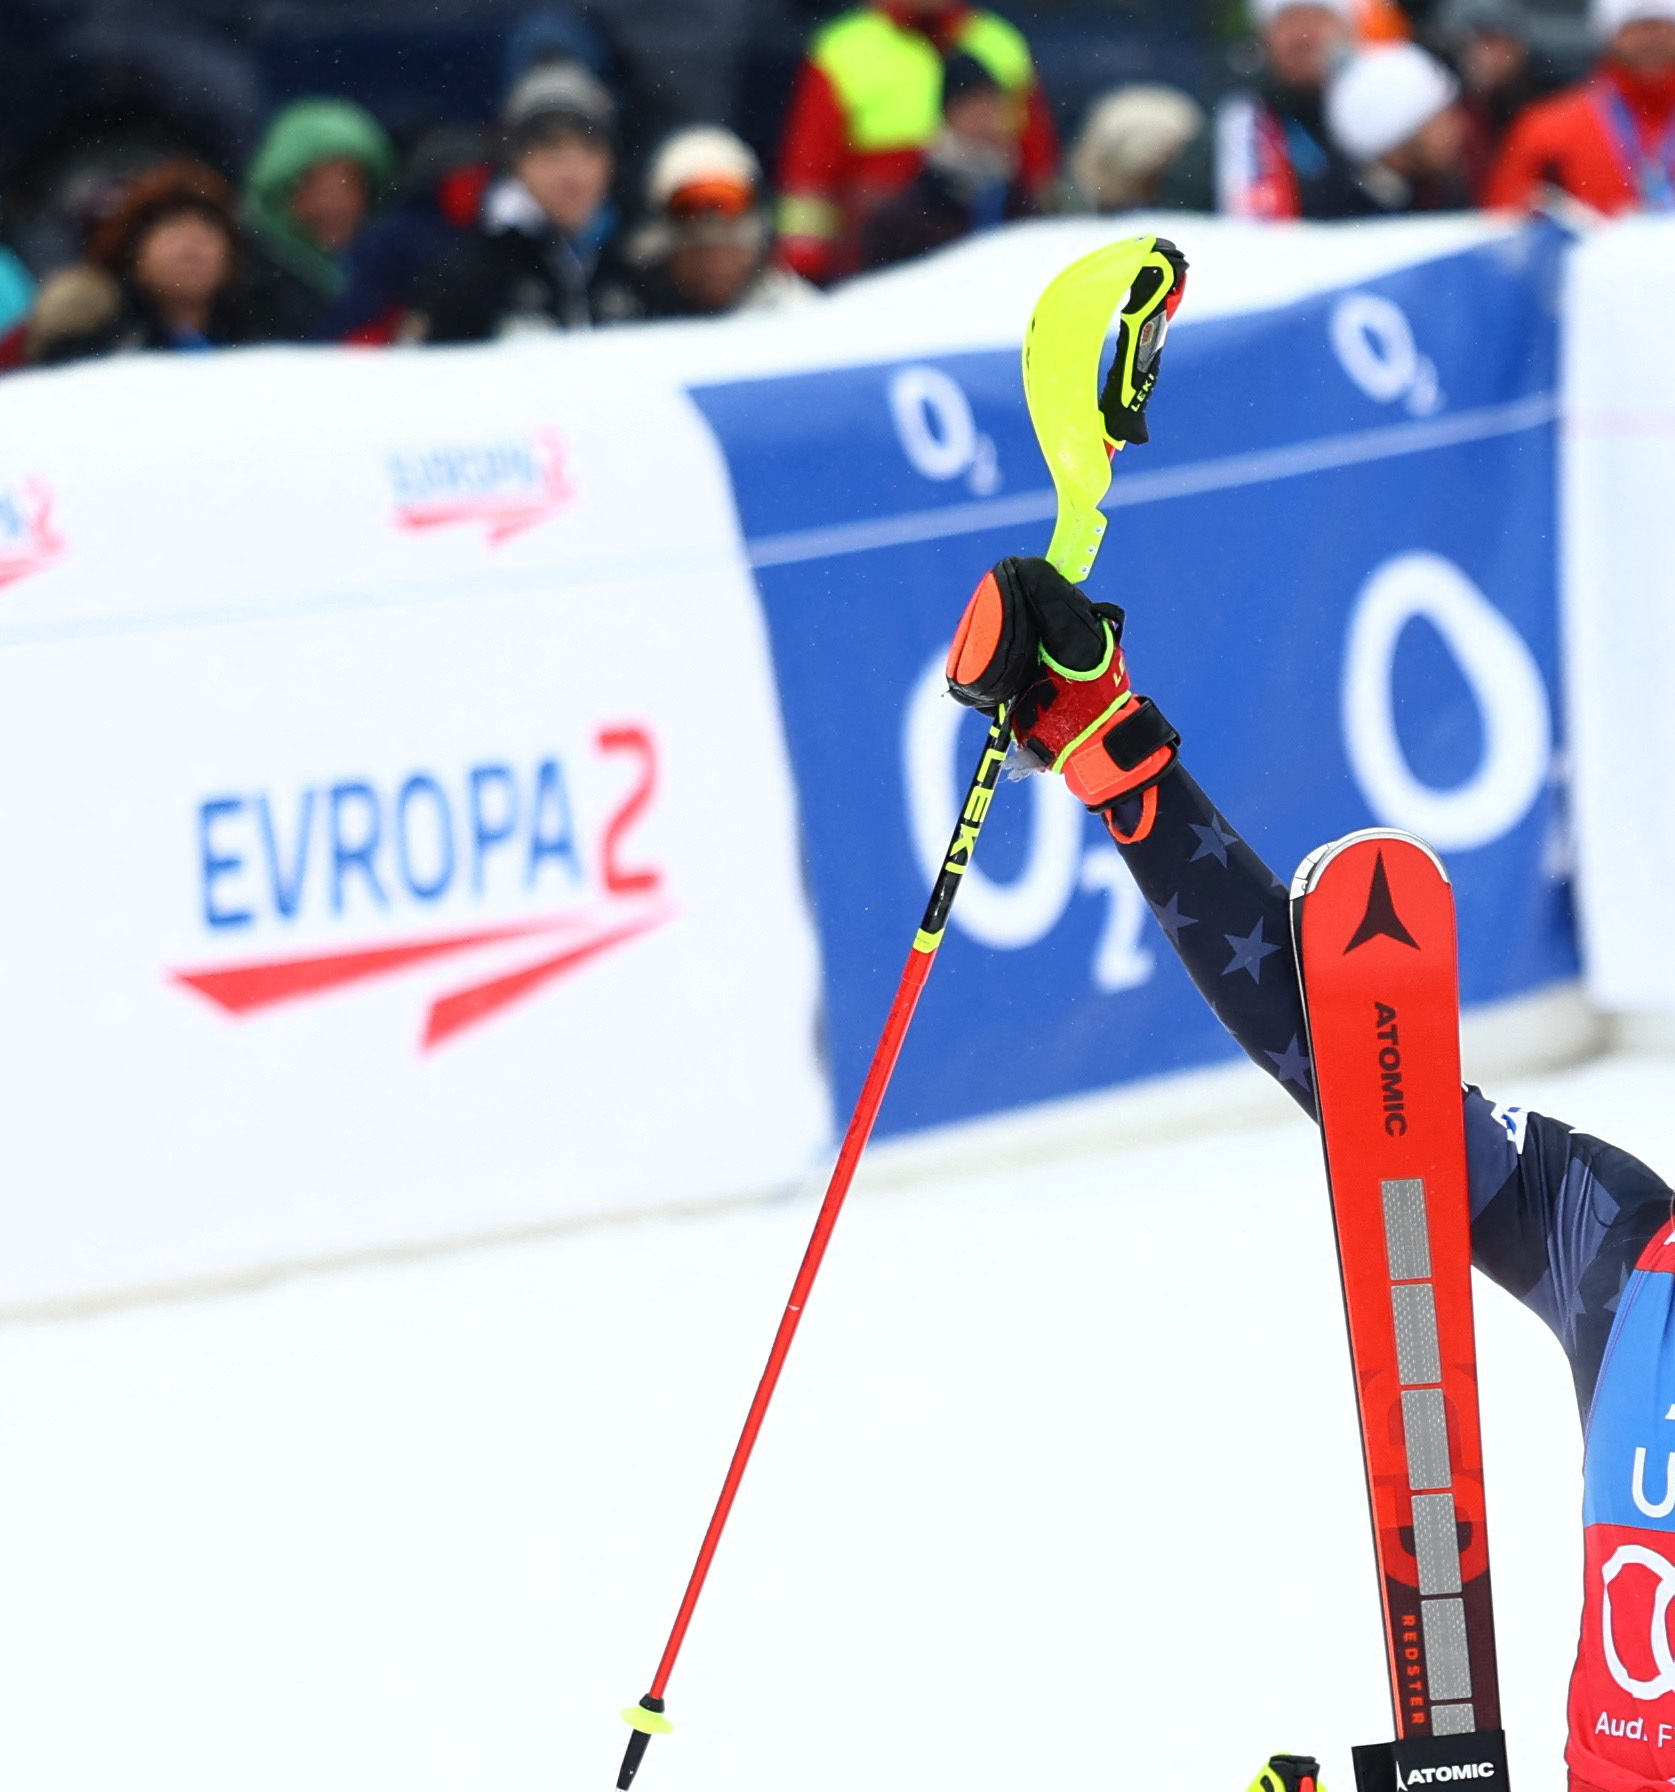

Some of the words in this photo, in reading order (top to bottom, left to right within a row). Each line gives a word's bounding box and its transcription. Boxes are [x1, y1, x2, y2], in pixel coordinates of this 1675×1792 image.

[1130, 372, 1157, 413] LEKI
[944, 747, 1008, 876] LEKI
[1373, 1000, 1409, 1138] ATOMIC
[1399, 1614, 1427, 1726] REDSTER
[1406, 1762, 1496, 1786] ATOMIC
